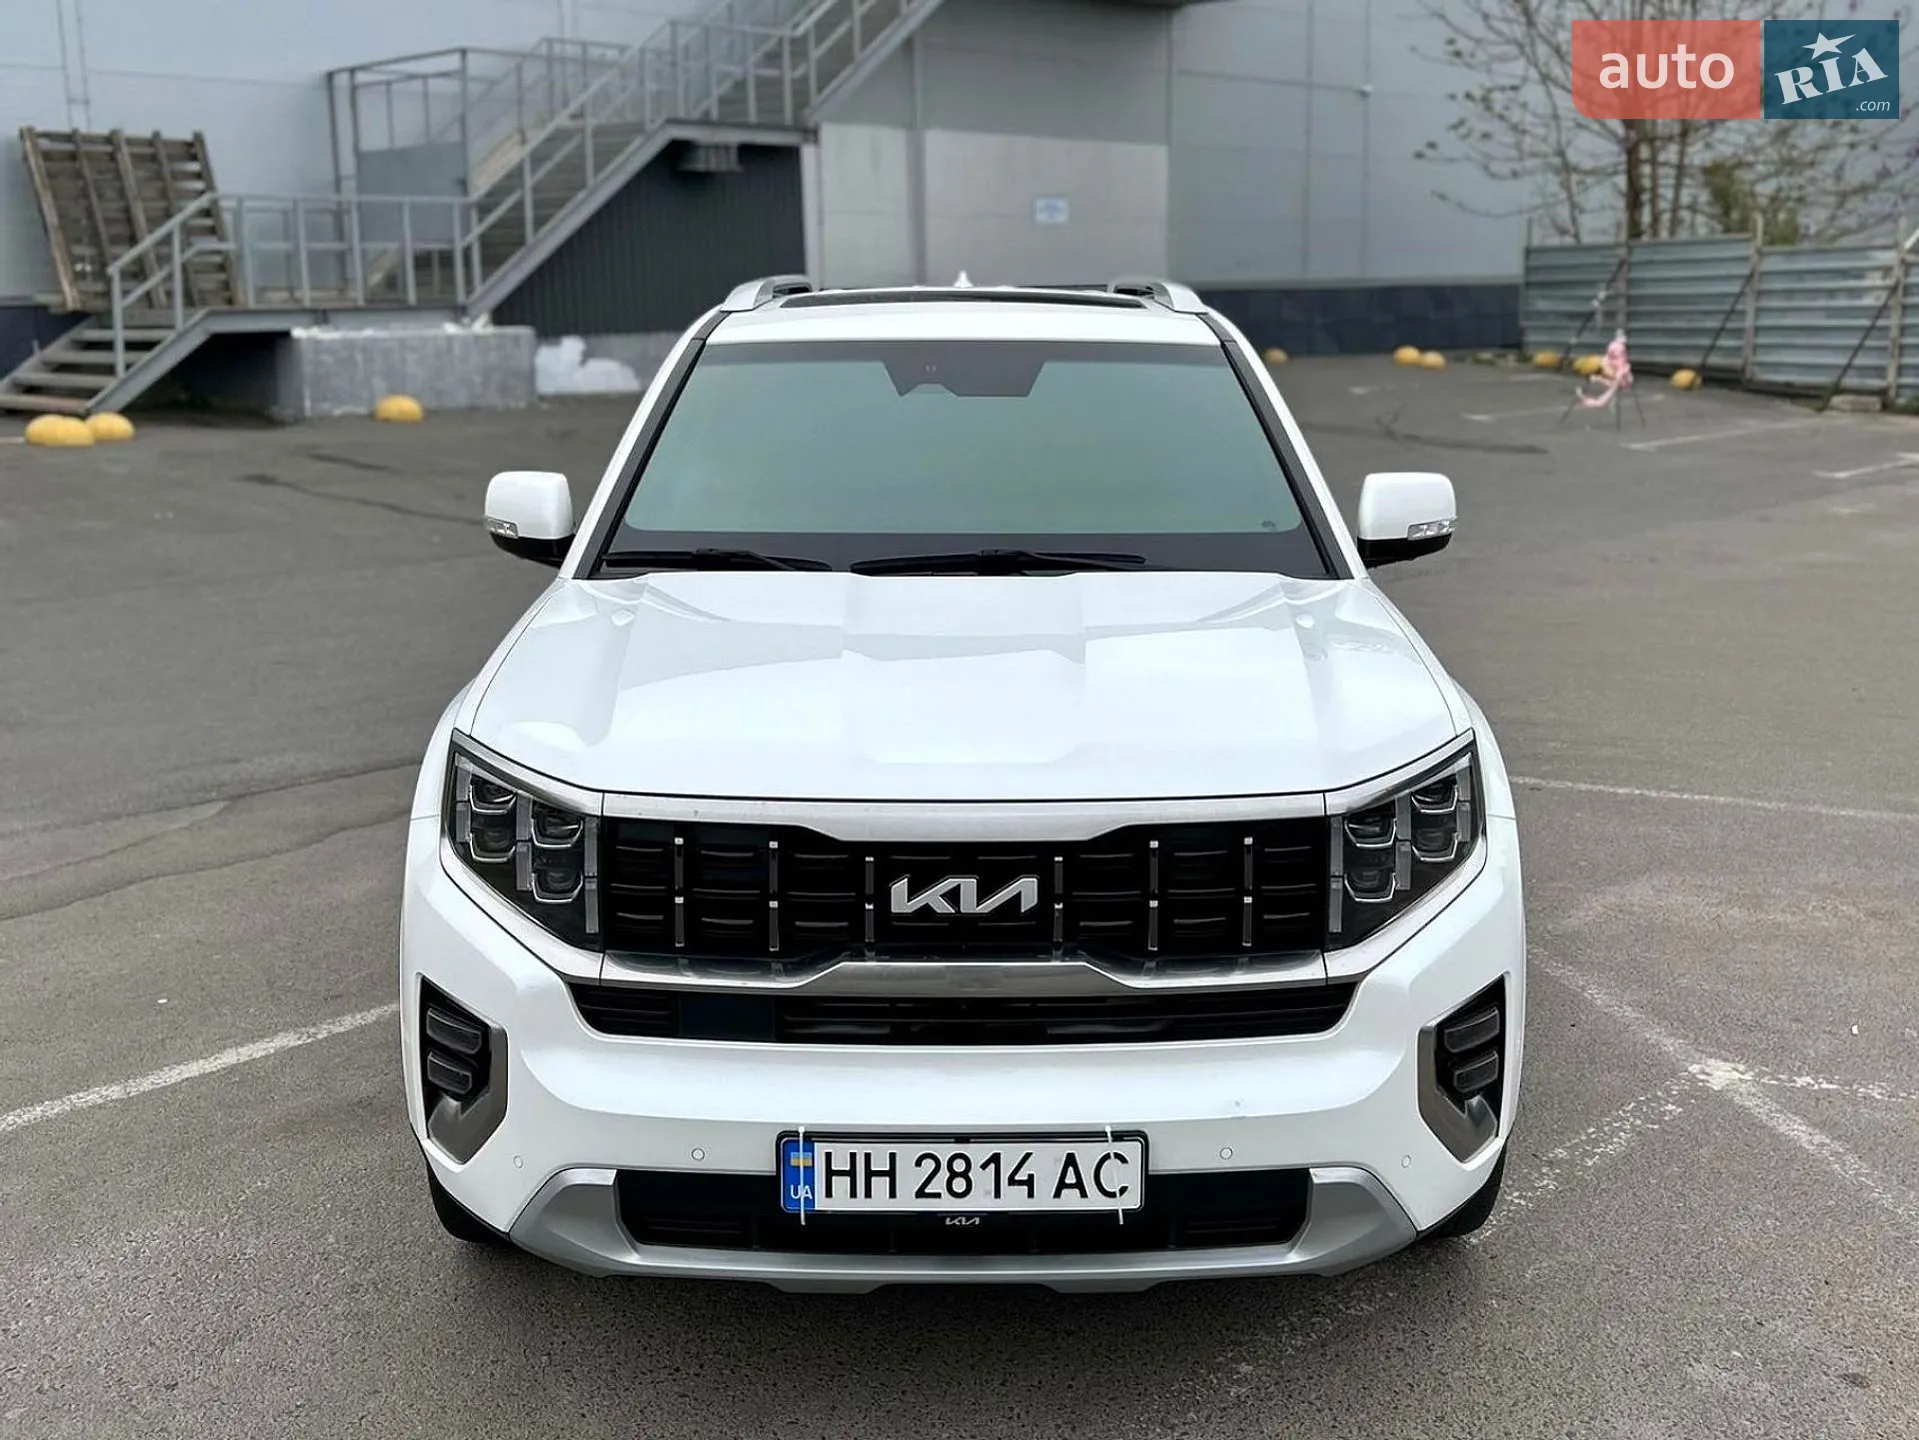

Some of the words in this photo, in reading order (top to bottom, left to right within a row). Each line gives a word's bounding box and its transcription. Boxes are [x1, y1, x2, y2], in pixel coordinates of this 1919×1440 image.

[890, 877, 1038, 913] KIA
[790, 1184, 813, 1200] UA
[824, 1151, 898, 1200] HH
[914, 1151, 1036, 1200] 2814
[1052, 1151, 1130, 1200] AC
